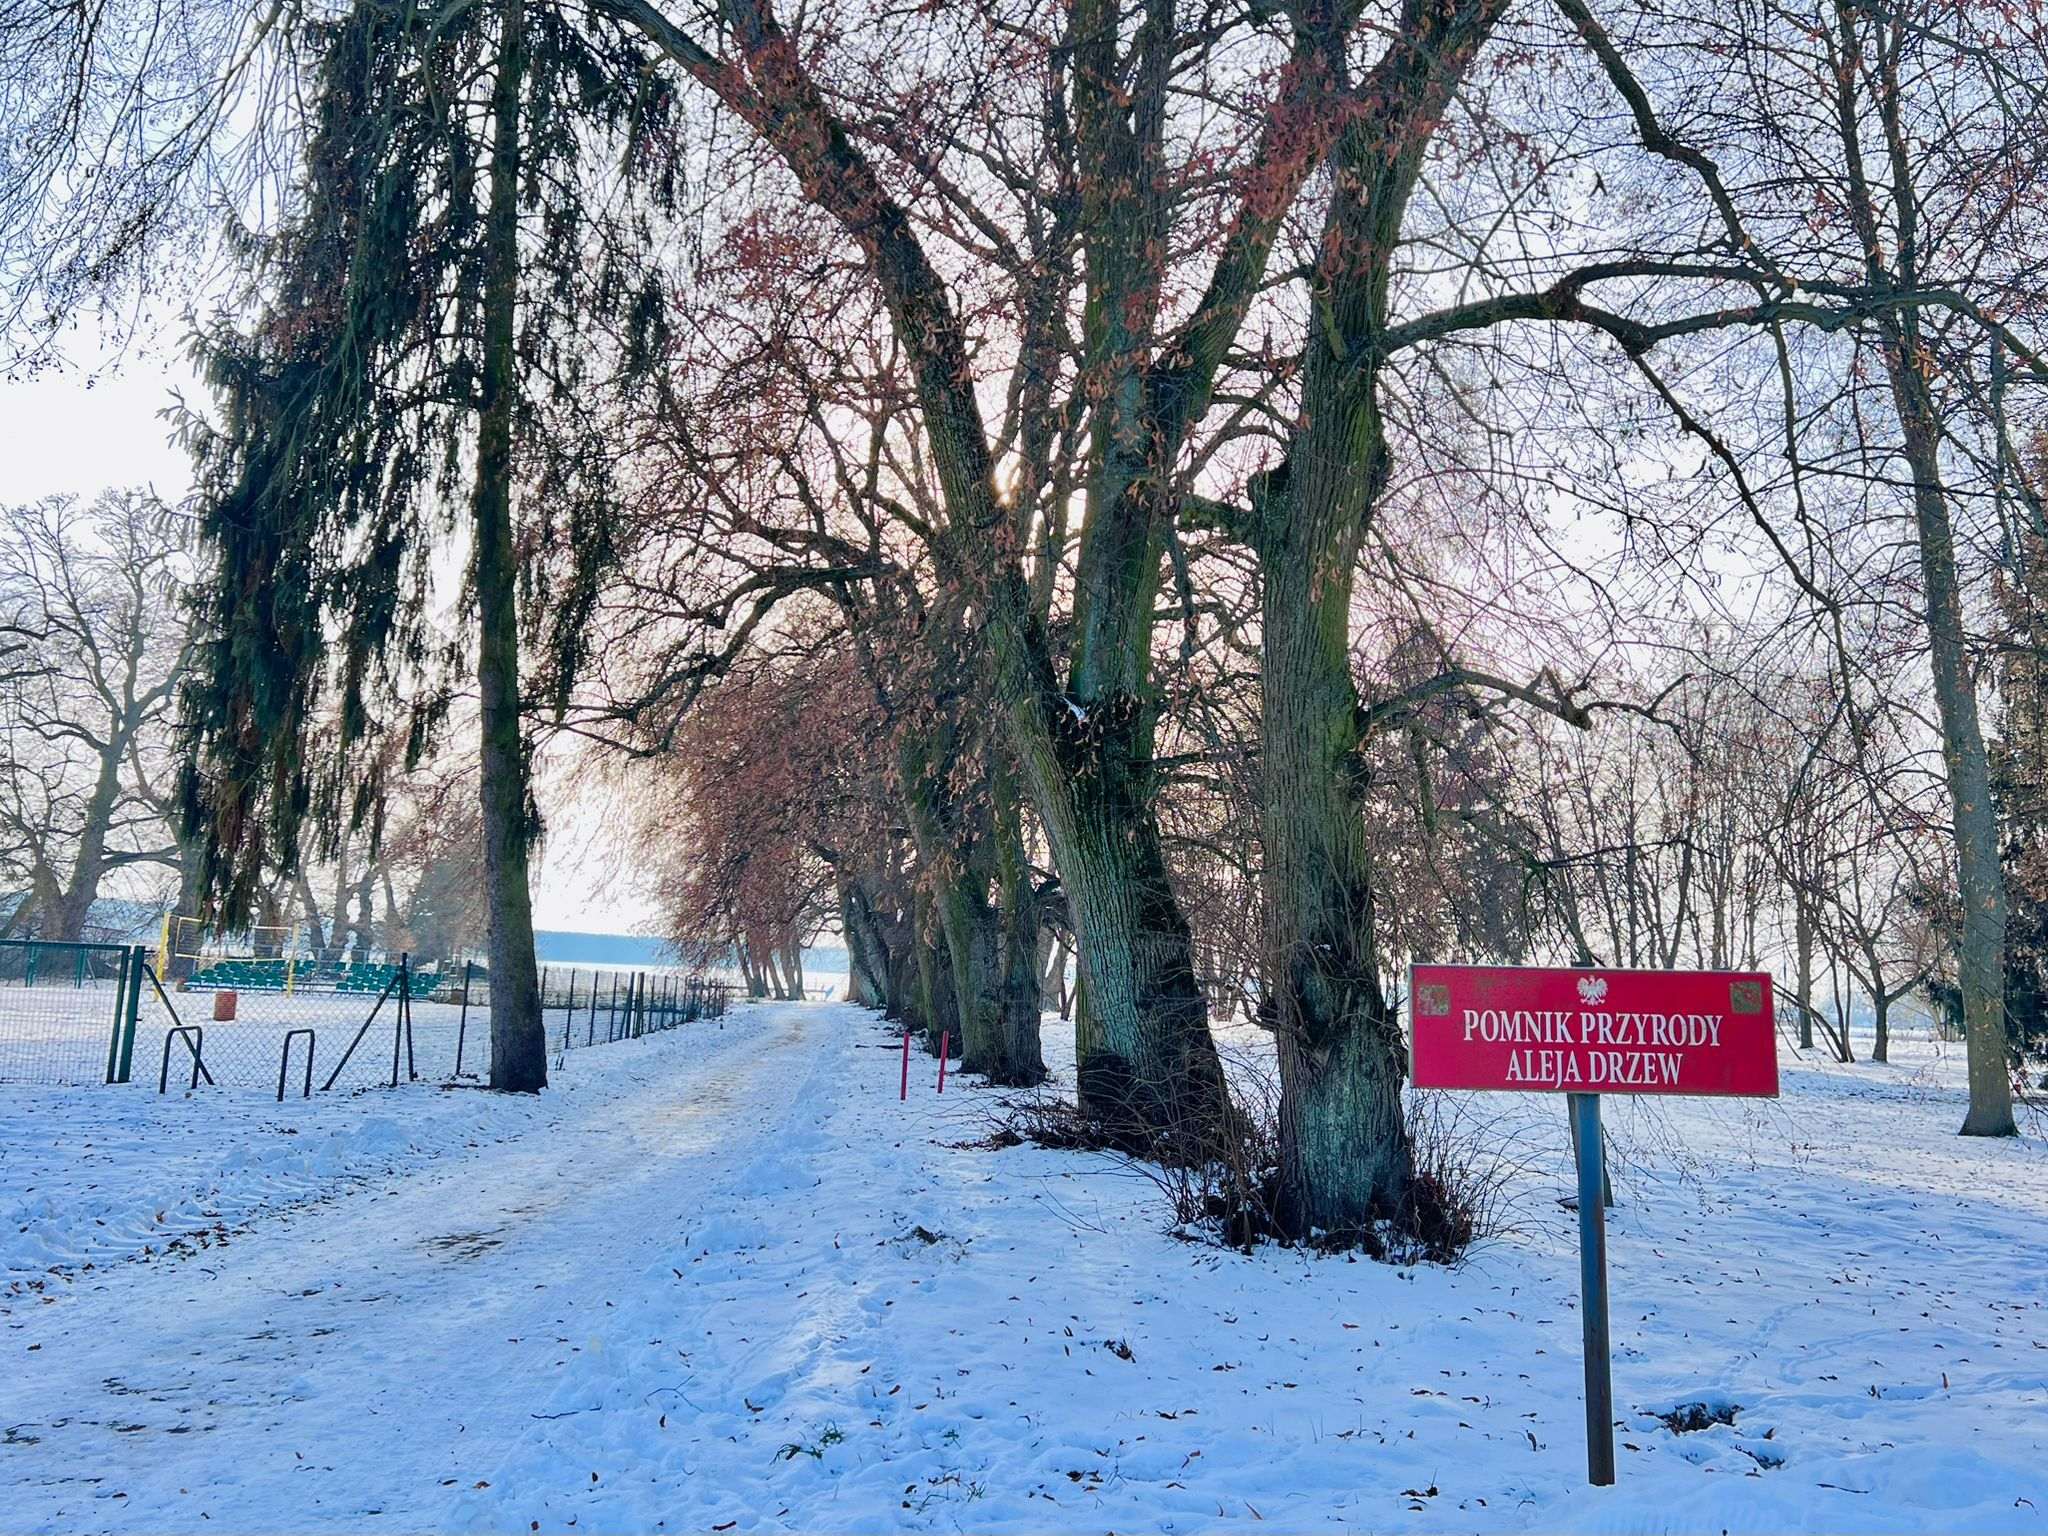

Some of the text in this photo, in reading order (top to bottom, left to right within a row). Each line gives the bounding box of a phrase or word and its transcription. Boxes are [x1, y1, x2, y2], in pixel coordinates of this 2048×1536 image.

[1463, 1009, 1722, 1046] POMNIK PRZYRODY
[1505, 1049, 1683, 1089] ALEJA DRZEW
